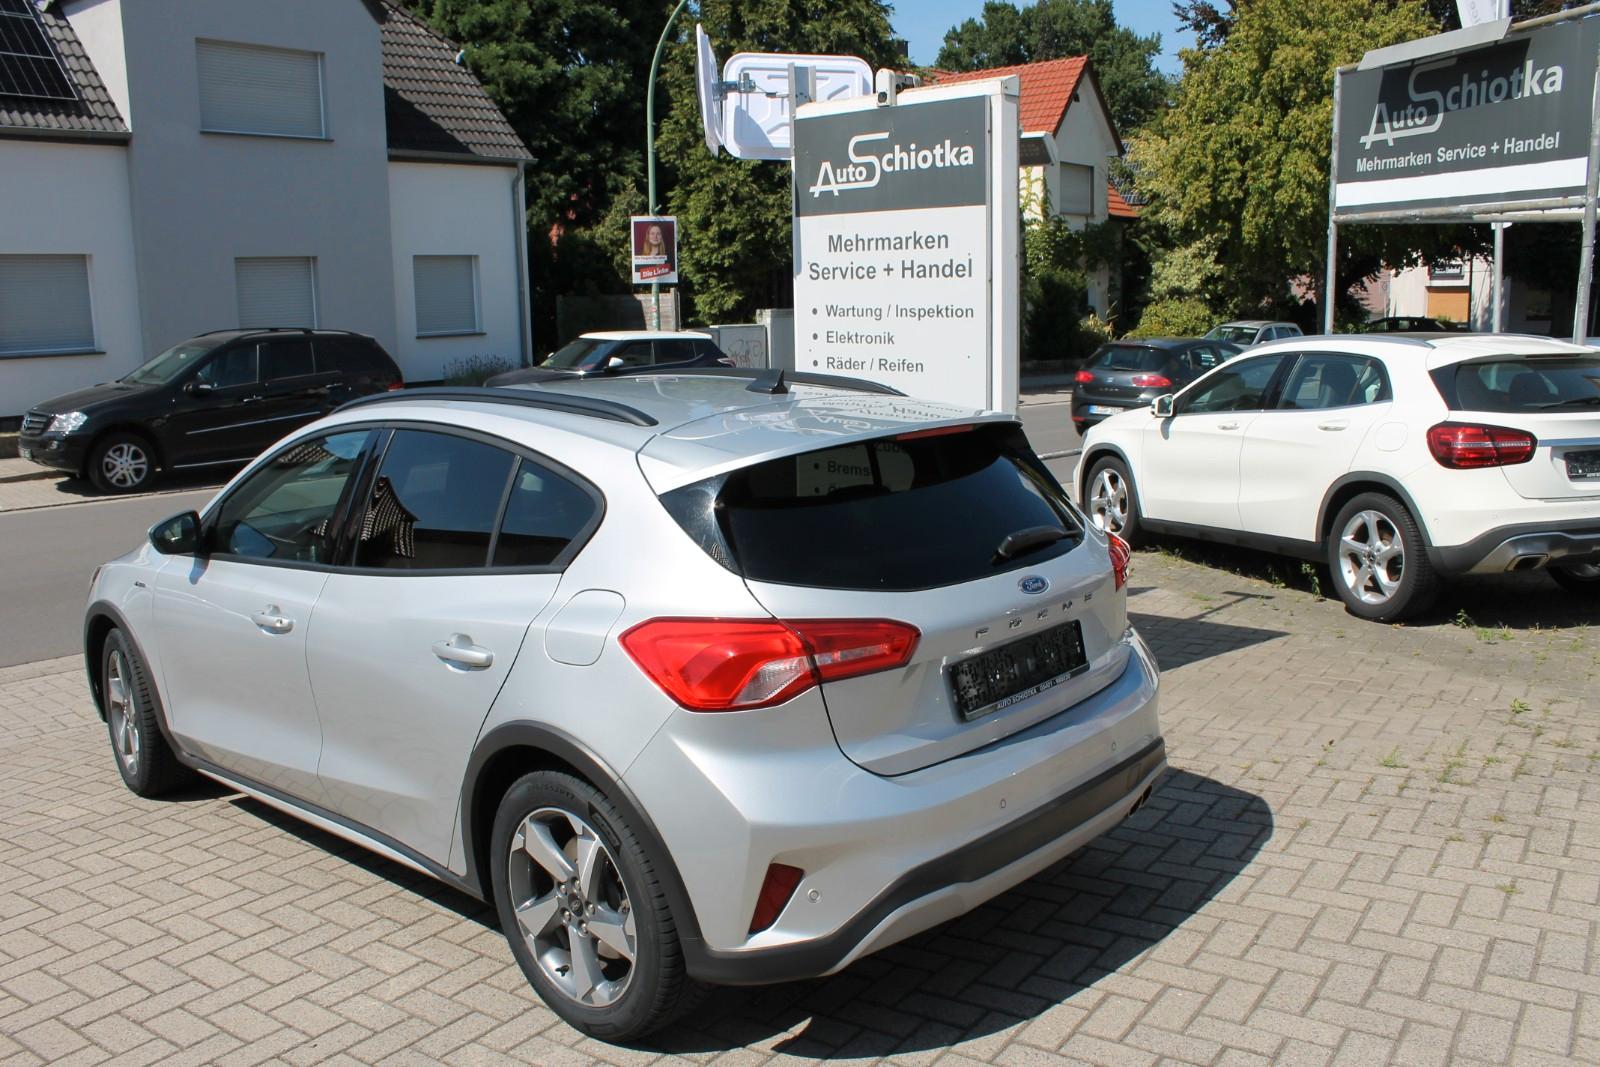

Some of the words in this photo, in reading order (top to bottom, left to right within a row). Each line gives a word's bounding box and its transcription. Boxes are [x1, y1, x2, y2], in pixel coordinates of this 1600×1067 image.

[1360, 102, 1428, 150] Auto
[1408, 57, 1563, 133] Schiotka
[1356, 151, 1432, 173] Mehrmarken
[1437, 143, 1486, 163] Service
[1491, 142, 1500, 154] +
[1503, 132, 1560, 155] Handel
[809, 161, 867, 198] Auto
[849, 131, 974, 188] Schiotka
[828, 231, 949, 253] Mehrmarken
[809, 262, 877, 281] Service
[883, 263, 895, 277] +
[901, 258, 973, 280] Handel
[826, 304, 883, 321] Wartung
[895, 304, 974, 321] Inspektion
[826, 330, 895, 345] Elektronik
[826, 356, 866, 371] Räder
[878, 358, 924, 373] Reifen
[827, 460, 871, 477] Brems
